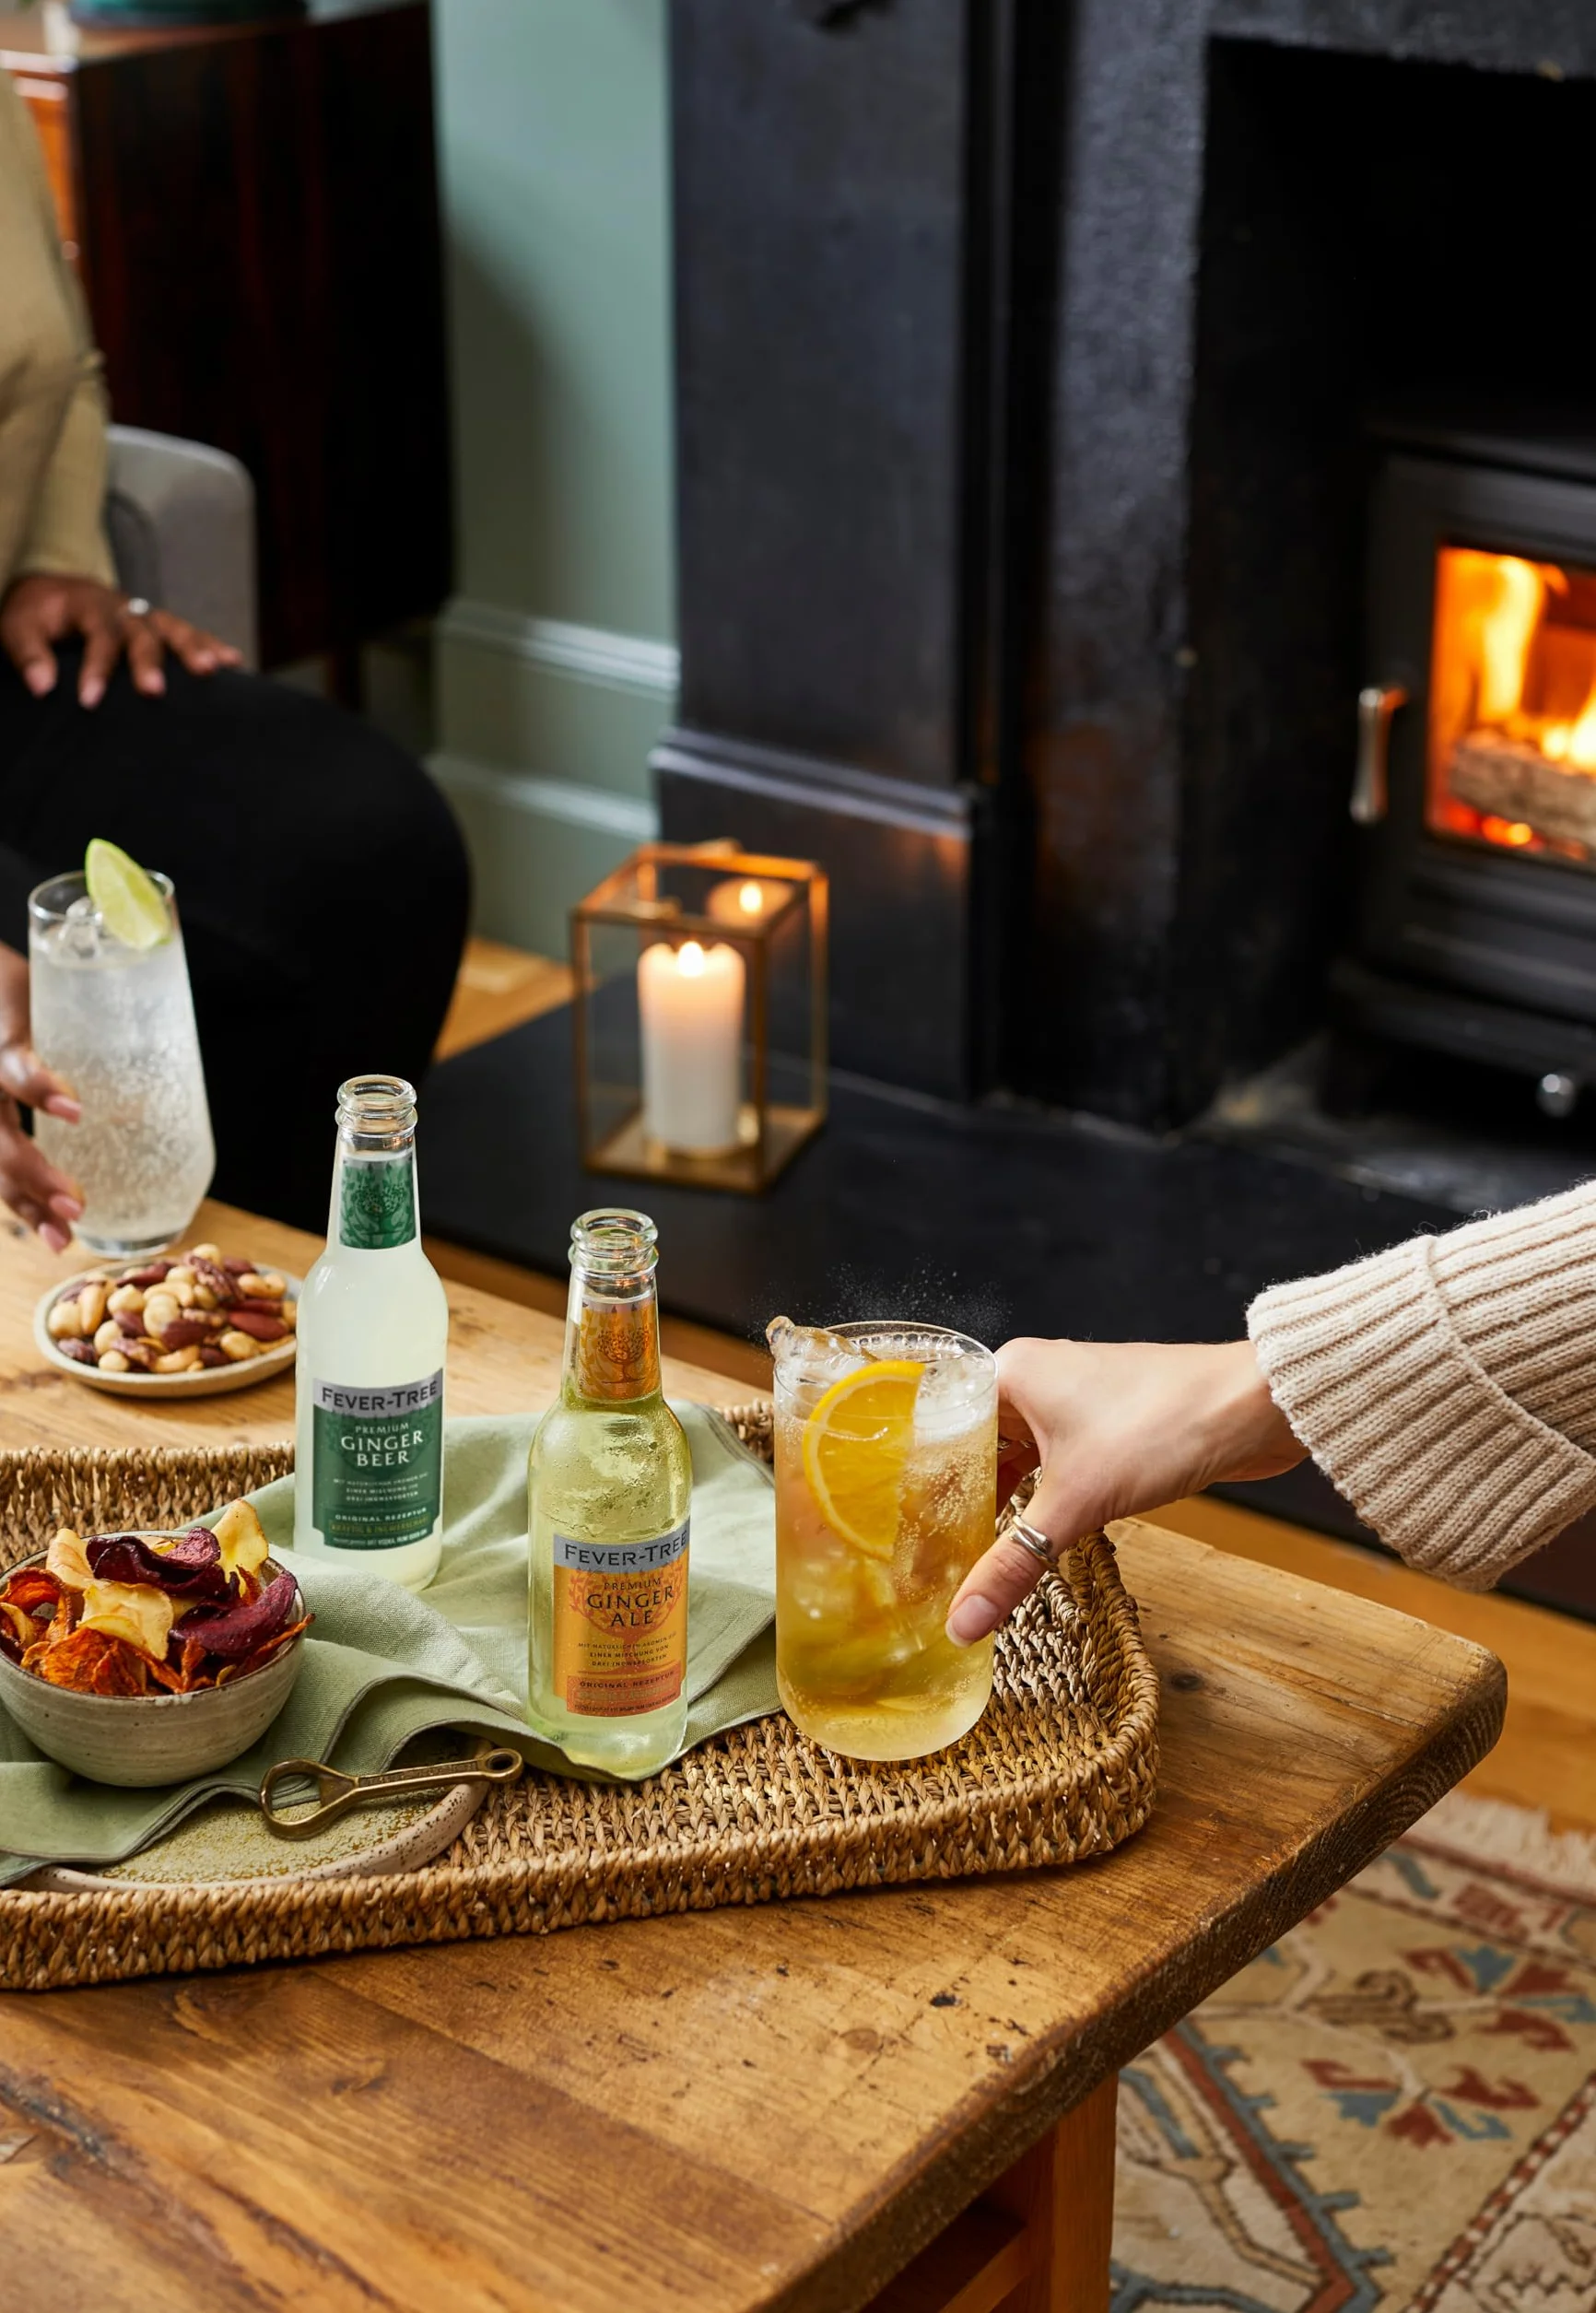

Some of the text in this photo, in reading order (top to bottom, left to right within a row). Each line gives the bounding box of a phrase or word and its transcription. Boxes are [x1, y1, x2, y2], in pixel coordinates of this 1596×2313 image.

[322, 1380, 437, 1411] FEVER-TREE
[356, 1422, 409, 1434] PREMIUM
[341, 1430, 423, 1451] GINGER
[357, 1450, 409, 1467] BEER
[334, 1514, 382, 1522] ORIGINAL
[565, 1530, 687, 1566] FEVER-TREE
[604, 1578, 662, 1591] PREMIUM
[587, 1585, 674, 1609] GINGER
[610, 1610, 654, 1627] ALE
[580, 1680, 628, 1688] ORIGINAL
